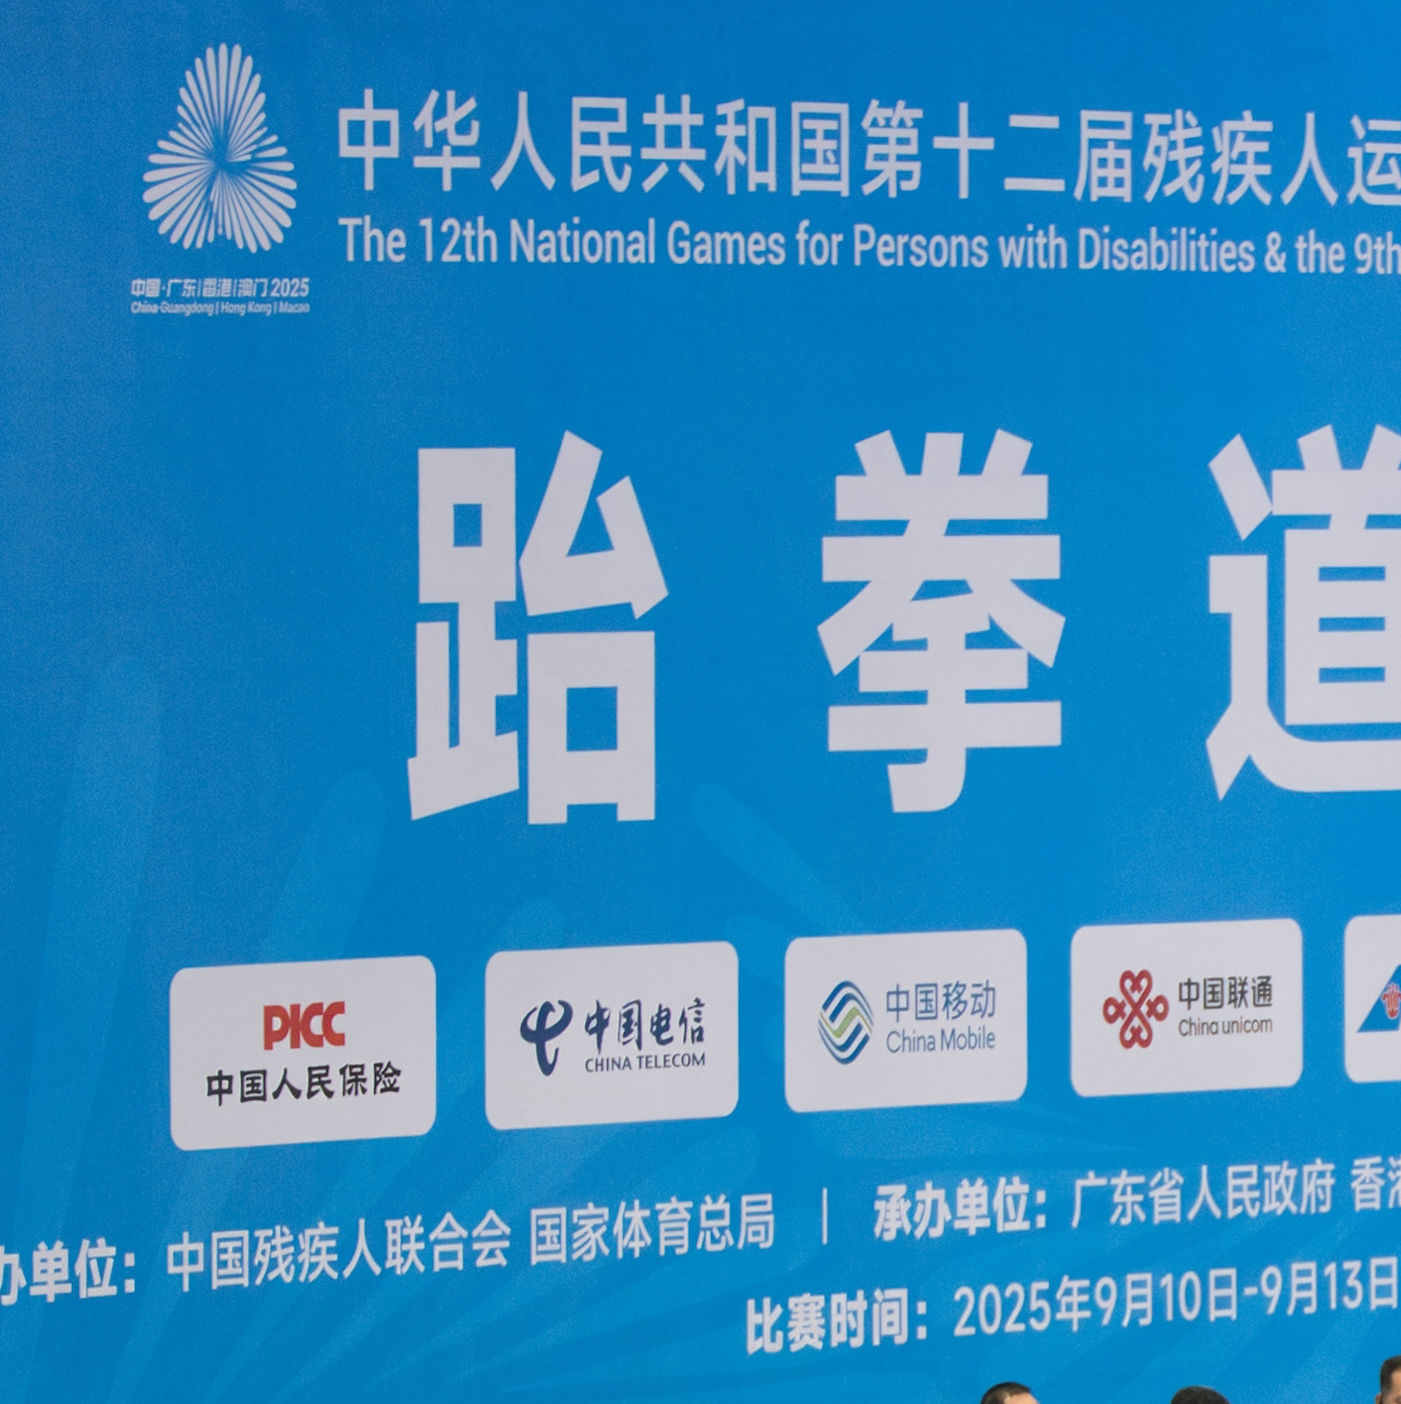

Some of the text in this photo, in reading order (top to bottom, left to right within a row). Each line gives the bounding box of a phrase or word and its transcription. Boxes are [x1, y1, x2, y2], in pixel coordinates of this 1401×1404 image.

[338, 215, 406, 262] The
[419, 216, 497, 262] 12th
[510, 216, 655, 263] National
[668, 220, 786, 265] Games
[795, 219, 843, 265] for
[854, 224, 988, 268] Persons
[998, 224, 1067, 268] with
[1079, 225, 1255, 272] Disabilities
[1265, 231, 1286, 272] &
[1295, 229, 1345, 273] the
[270, 277, 309, 297] 2025
[886, 980, 995, 1022] 中国移动
[1179, 976, 1272, 1010] 中国联通
[264, 1001, 345, 1050] PICC
[585, 998, 704, 1054] 中国电信
[887, 1025, 995, 1053] China Mobile
[1179, 1017, 1272, 1037] China unicom
[207, 1061, 401, 1106] 中国人民保险
[585, 1053, 705, 1072] CHINA TELECOM
[167, 1209, 511, 1292] 中国残疾人联合会
[531, 1193, 774, 1265] 国家体育总局
[1072, 1158, 1335, 1228] 广东省人民政府
[954, 1256, 1398, 1336] 2025年9月10日-9月13日
